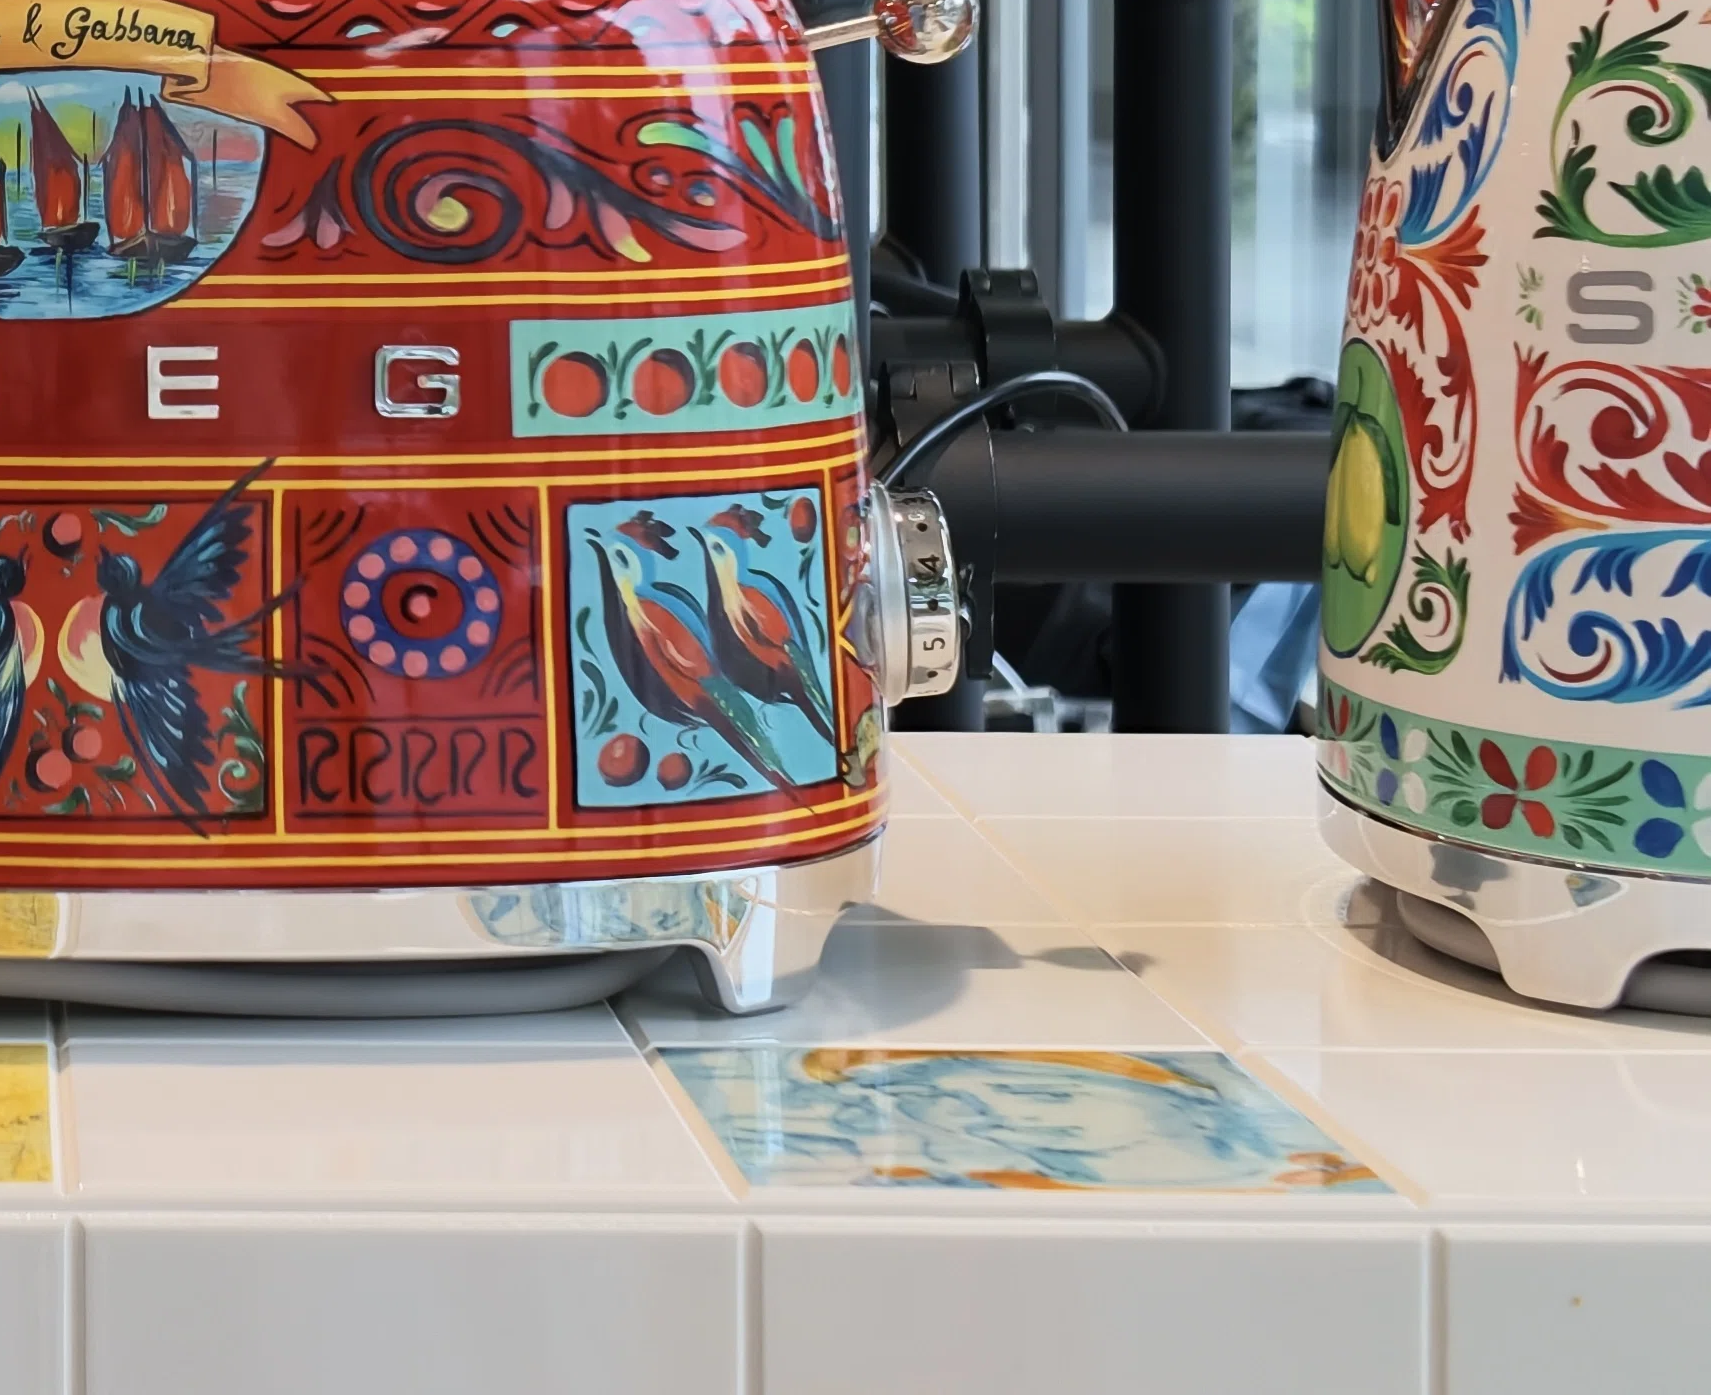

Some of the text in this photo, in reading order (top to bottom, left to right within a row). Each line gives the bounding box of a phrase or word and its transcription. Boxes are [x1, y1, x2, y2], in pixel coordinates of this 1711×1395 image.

[22, 1, 43, 52] &
[917, 554, 940, 573] 4
[923, 636, 946, 652] 5
